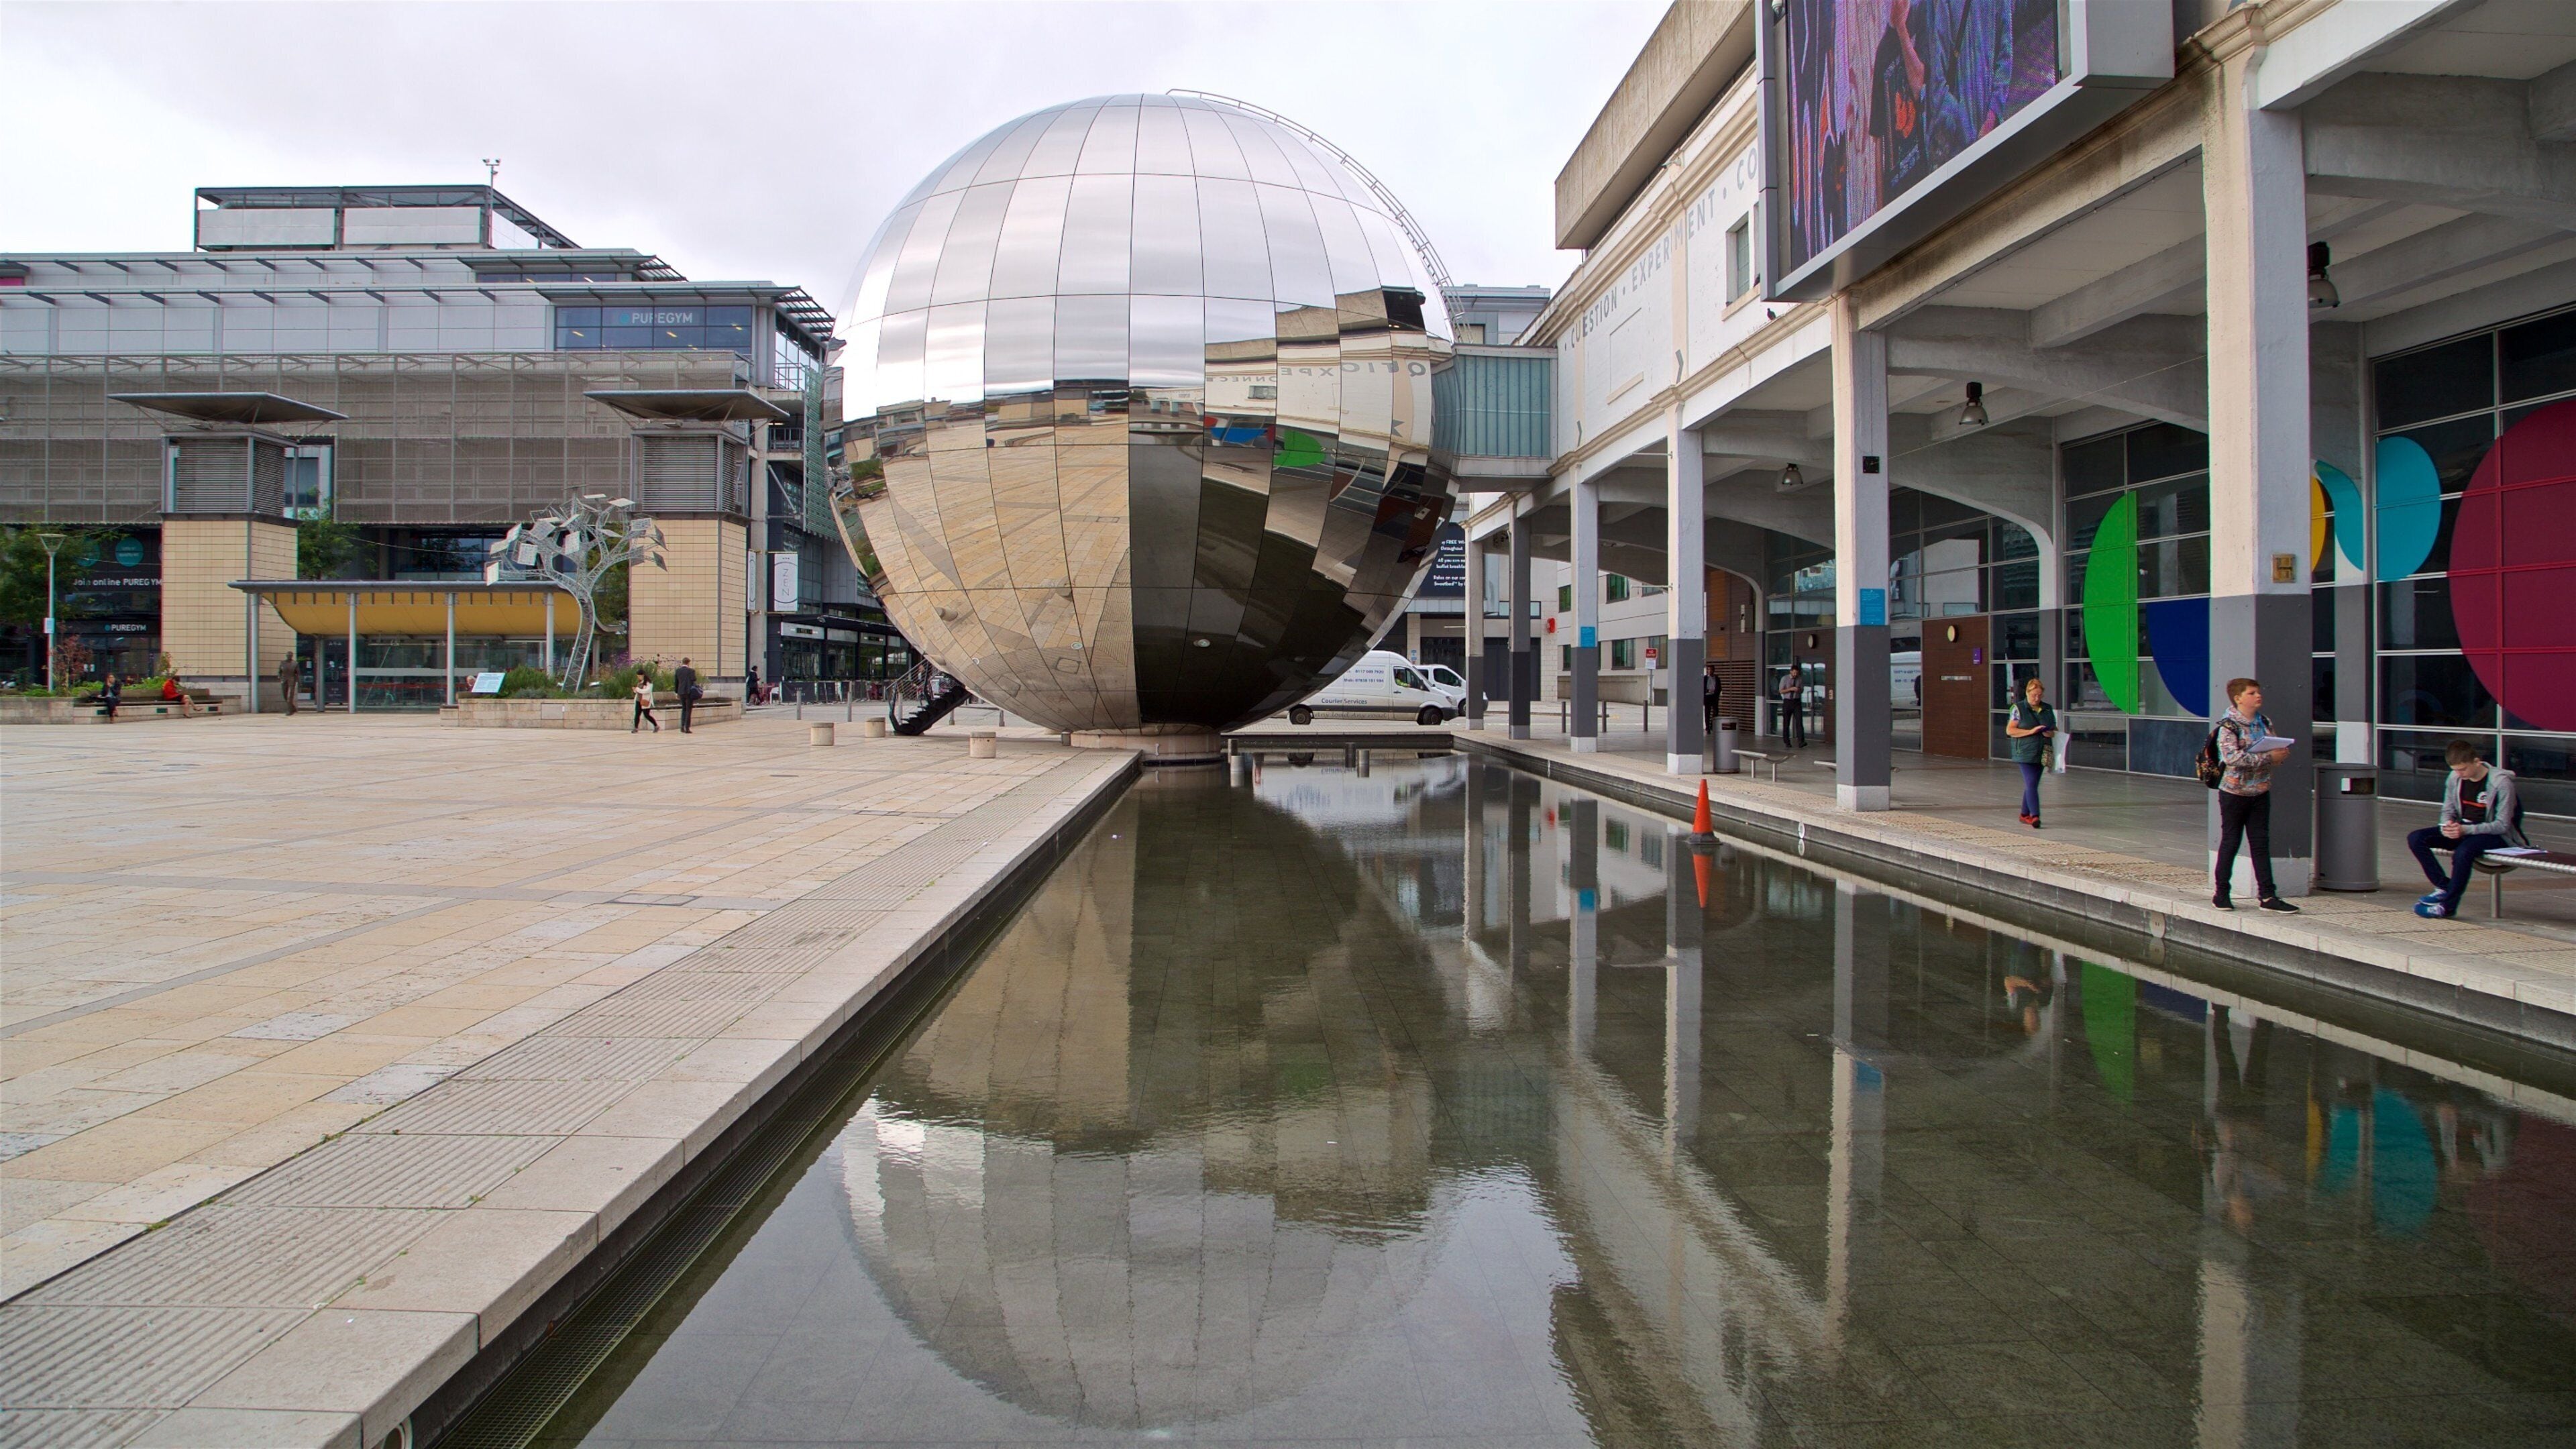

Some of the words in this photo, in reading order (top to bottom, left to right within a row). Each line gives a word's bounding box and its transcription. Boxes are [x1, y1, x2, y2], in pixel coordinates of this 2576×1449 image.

[1631, 189, 1715, 292] EXPERIMENT
[1736, 147, 1758, 191] CO
[632, 313, 693, 323] PUREGYM
[73, 578, 91, 586] Join
[93, 578, 121, 586] online
